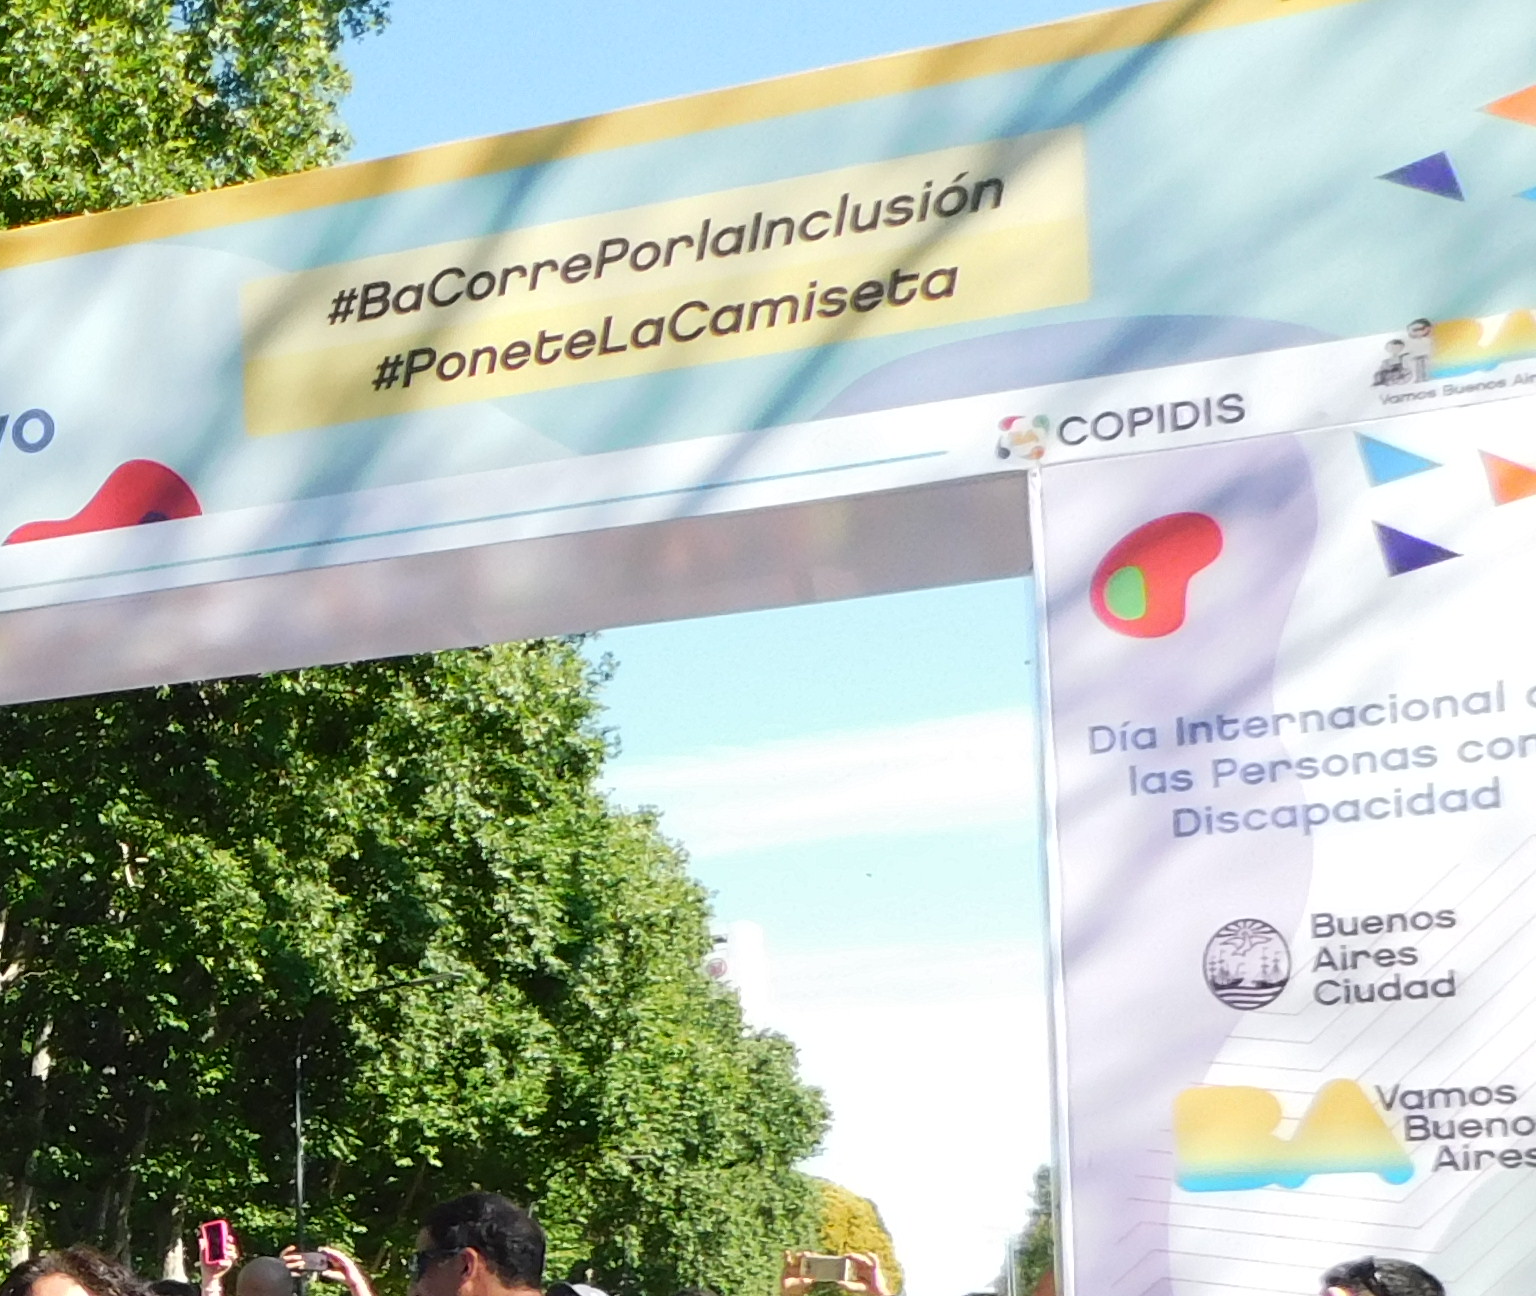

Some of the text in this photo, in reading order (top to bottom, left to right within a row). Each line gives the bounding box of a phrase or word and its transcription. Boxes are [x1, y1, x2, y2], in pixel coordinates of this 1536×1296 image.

[372, 260, 959, 392] #PoneteLaCamiseta
[1379, 389, 1436, 405] Vamos
[1443, 378, 1507, 397] Buenos
[1058, 393, 1245, 446] COPIDIS
[1088, 719, 1159, 756] Día
[1175, 680, 1506, 747] Internacional
[1129, 765, 1193, 798] las
[1212, 741, 1438, 789] Personas
[1173, 775, 1502, 839] Discapacidad
[1311, 908, 1458, 939] Buenos
[1312, 943, 1419, 974] Aires
[1314, 969, 1457, 1008] Ciudad
[1375, 1083, 1518, 1112] Vamos
